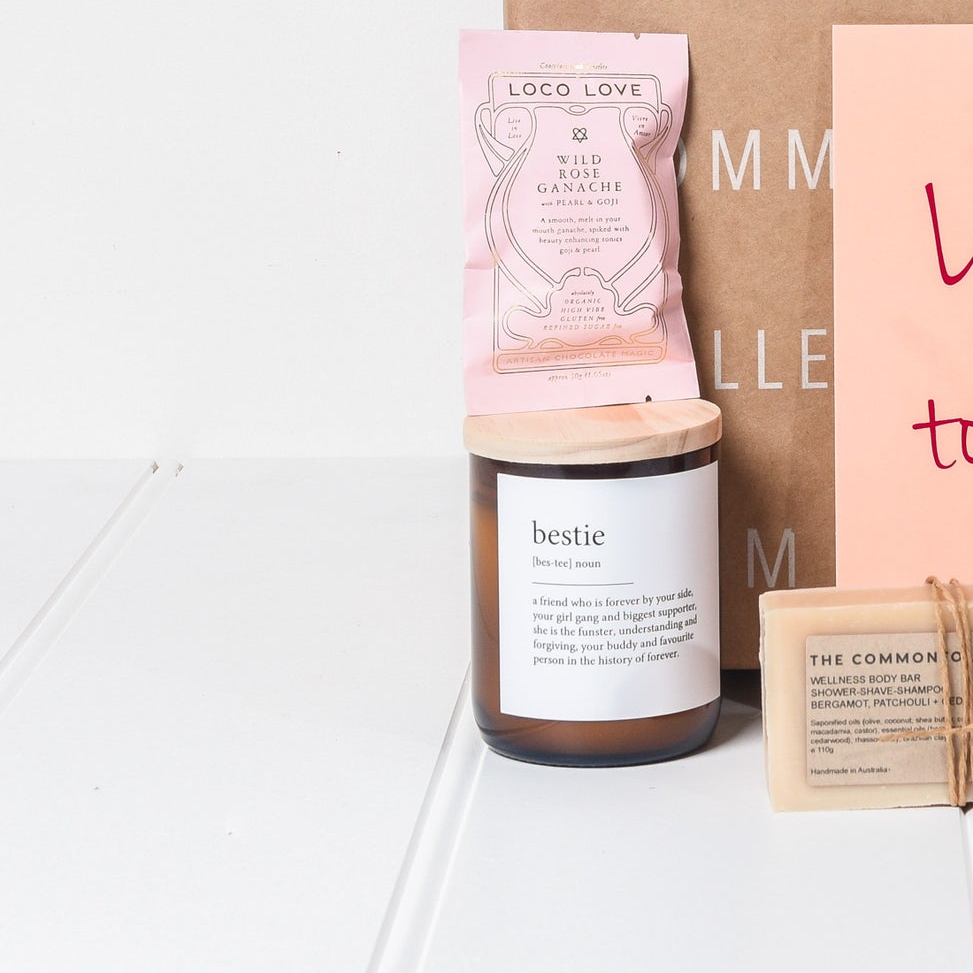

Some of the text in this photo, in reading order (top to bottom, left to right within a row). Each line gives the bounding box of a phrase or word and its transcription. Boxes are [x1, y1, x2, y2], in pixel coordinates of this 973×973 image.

[509, 83, 642, 96] LOCO LOVE
[557, 155, 601, 165] WILD
[559, 168, 600, 179] ROSE
[537, 182, 622, 193] GANACHE
[506, 356, 550, 364] ARTISAN
[555, 351, 617, 361] CHOCOLATE
[532, 520, 605, 546] bestie
[532, 556, 601, 569] [bes-tee] noun
[533, 588, 694, 607] a friend who is forever by your side,
[533, 602, 697, 625] your girl gang and biggest supporter,
[533, 616, 698, 637] she is the funster, understanding and
[533, 631, 694, 653] forgiving, your buddy and favourite
[533, 649, 680, 667] person in the history of forever.
[810, 654, 843, 666] THE
[810, 674, 920, 685] WELLNESS BODY BAR
[811, 700, 870, 709] BERGAMOT,
[874, 698, 930, 707] PATCHOULI
